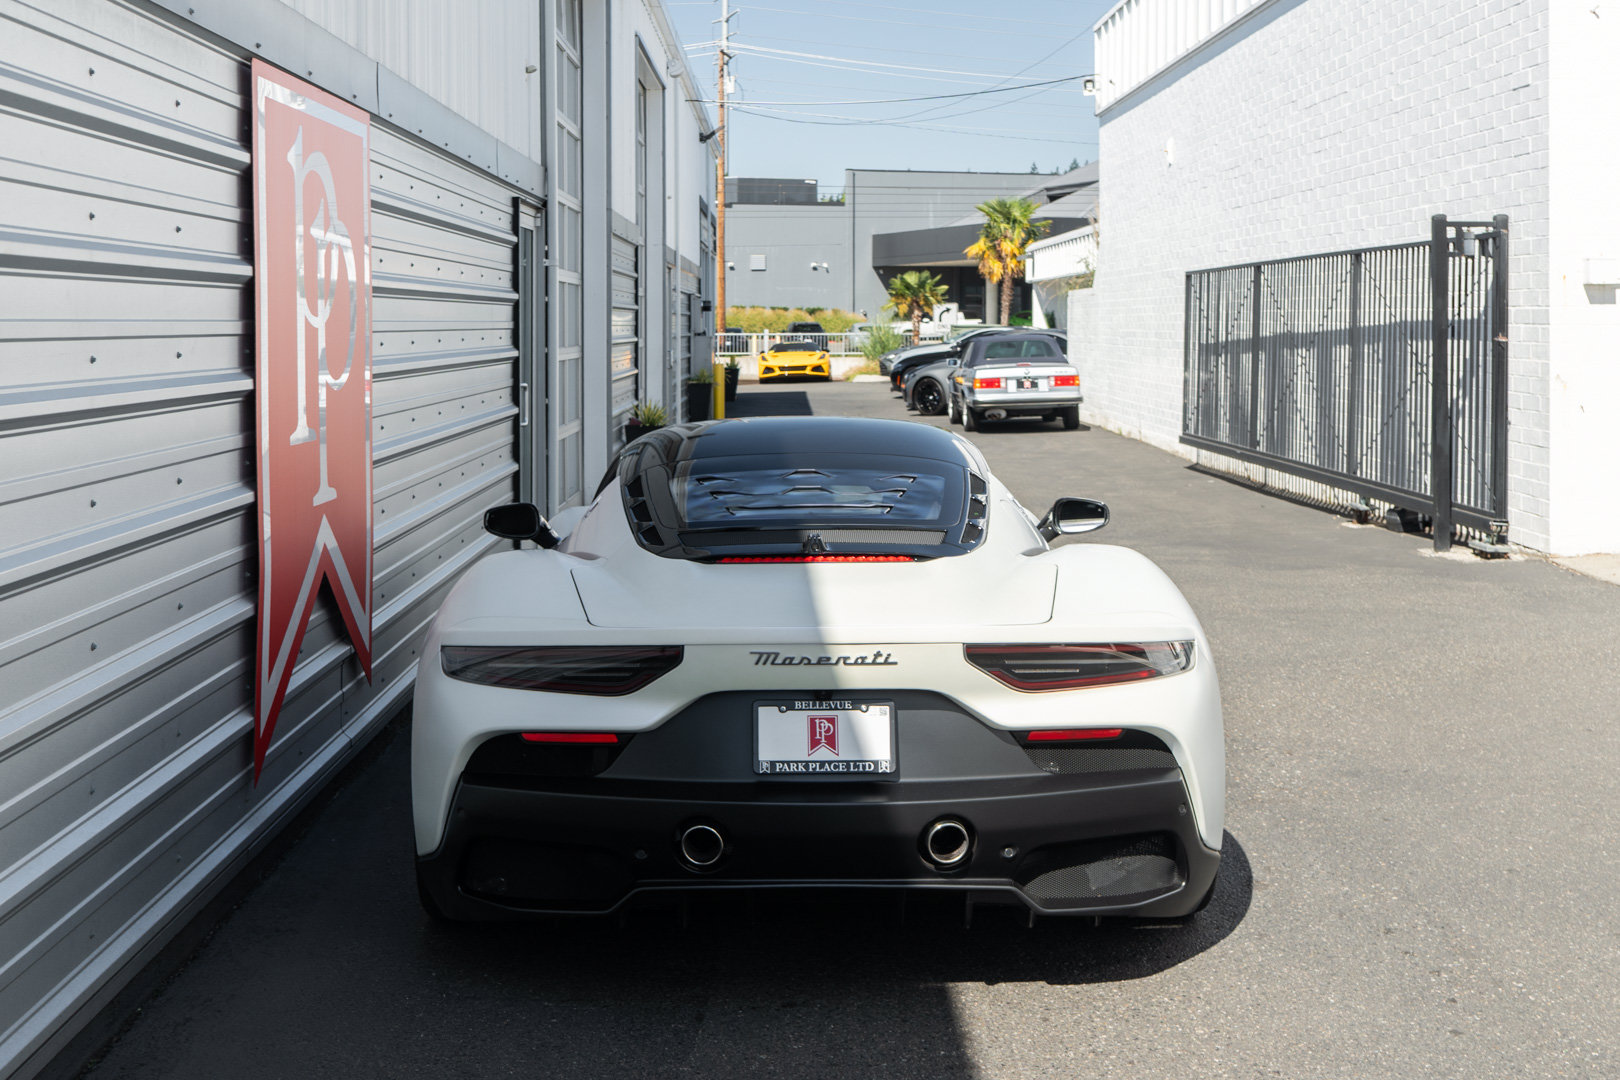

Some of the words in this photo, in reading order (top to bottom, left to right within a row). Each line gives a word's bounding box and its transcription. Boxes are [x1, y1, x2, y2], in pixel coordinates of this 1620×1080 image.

[749, 651, 898, 666] Maserati
[794, 701, 853, 710] BELLEVUE
[775, 762, 806, 772] PARK
[808, 762, 847, 772] PLACE
[849, 762, 875, 772] LTD
